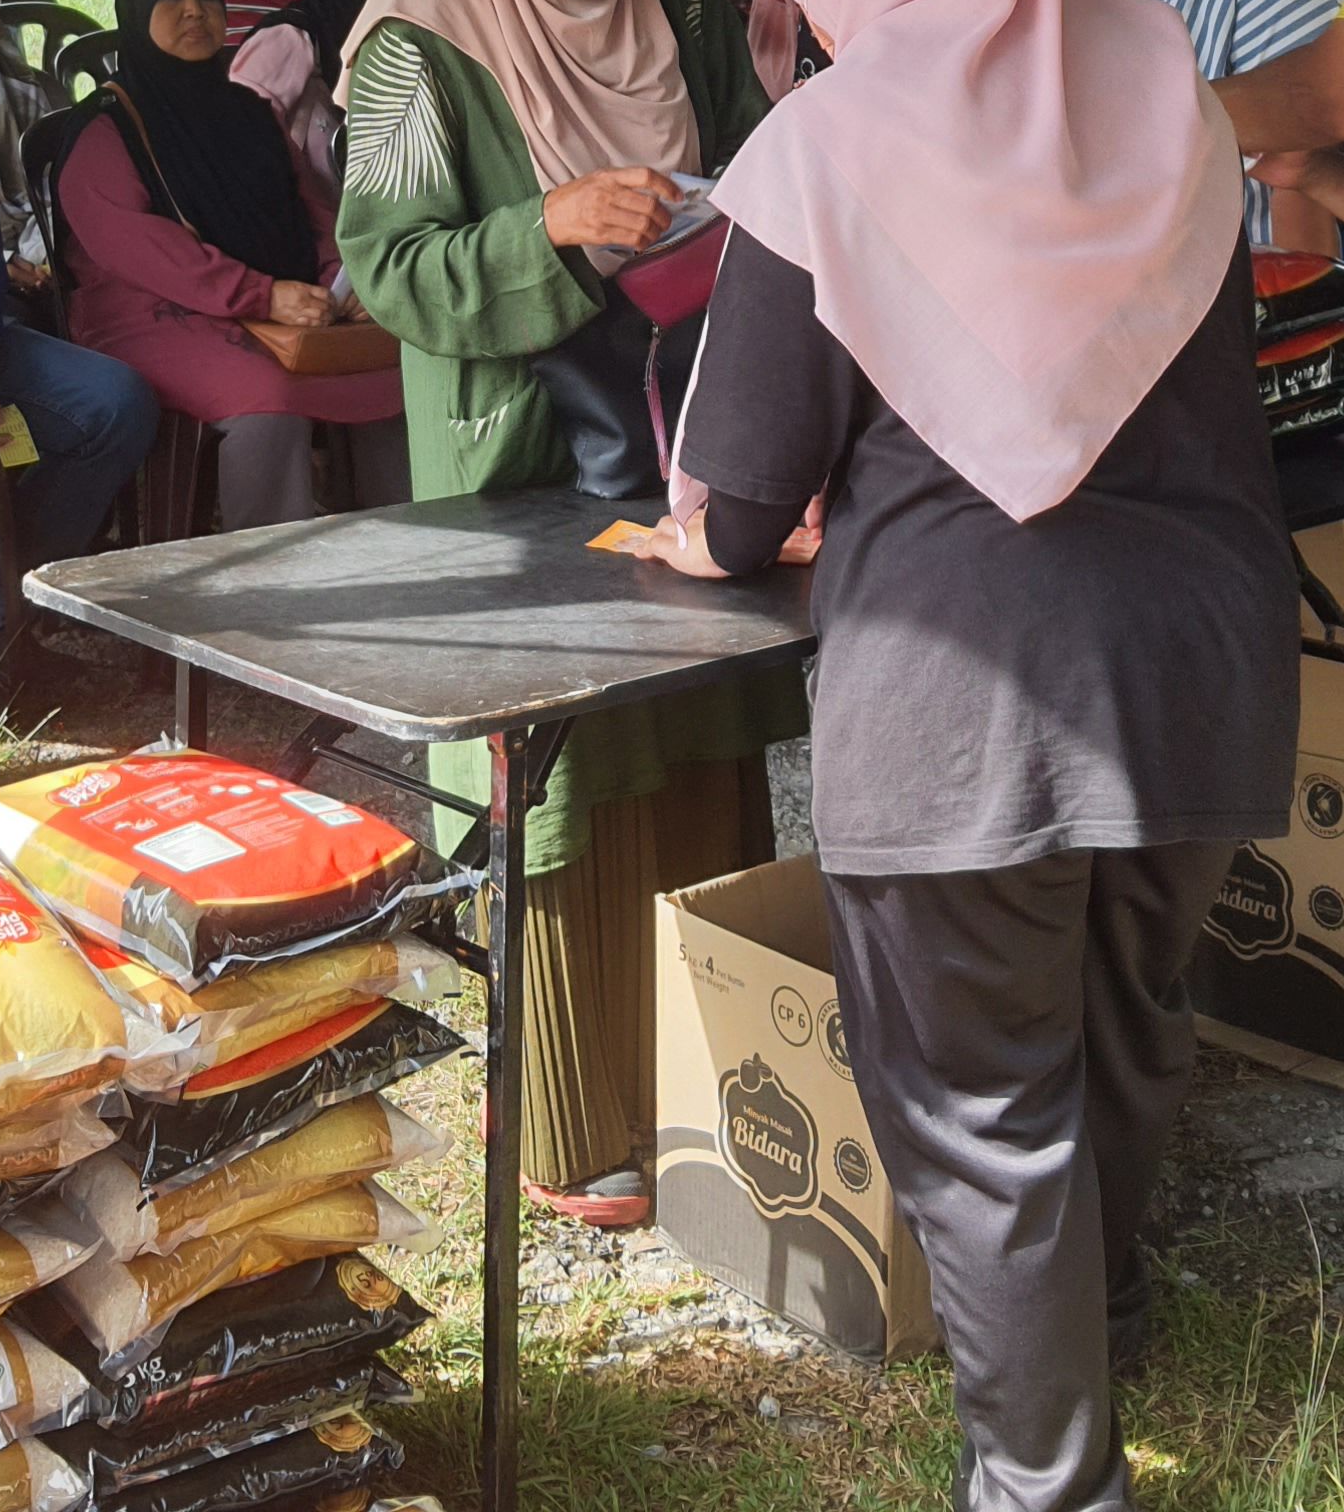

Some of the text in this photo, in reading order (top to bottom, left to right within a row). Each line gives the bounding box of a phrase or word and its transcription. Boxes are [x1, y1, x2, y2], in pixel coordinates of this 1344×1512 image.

[679, 943, 687, 962] 5
[706, 955, 714, 976] 4
[778, 1004, 806, 1029] CP 6
[828, 1056, 853, 1078] MALAY
[732, 1116, 803, 1175] Bidara
